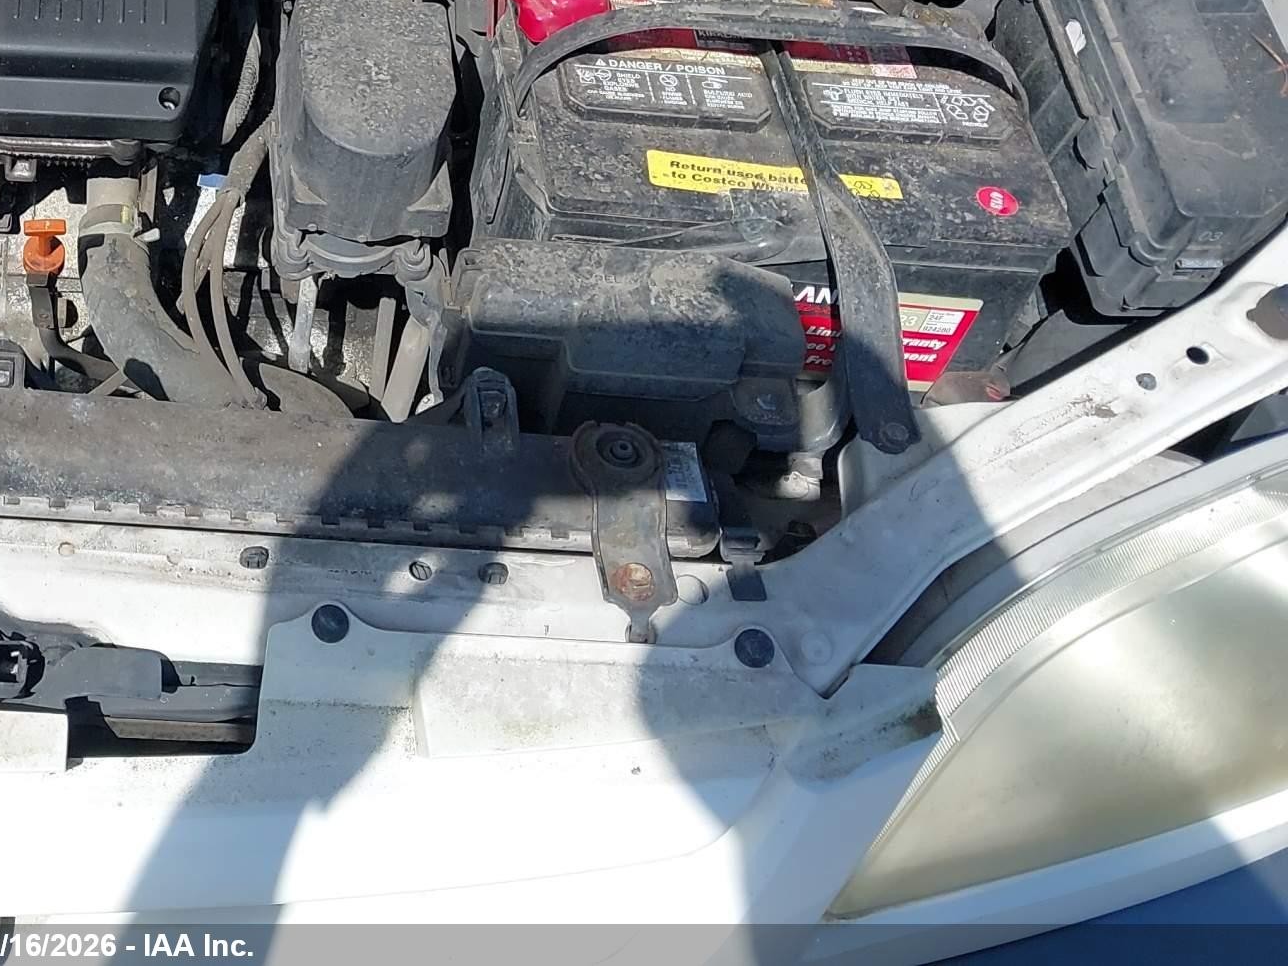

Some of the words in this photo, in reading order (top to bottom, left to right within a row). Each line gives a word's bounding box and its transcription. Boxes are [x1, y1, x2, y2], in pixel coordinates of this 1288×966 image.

[608, 59, 663, 71] DANGER
[676, 64, 726, 75] POISON
[669, 160, 722, 174] Return
[768, 174, 807, 185] batte
[671, 171, 686, 180] to
[692, 174, 746, 188] Costco
